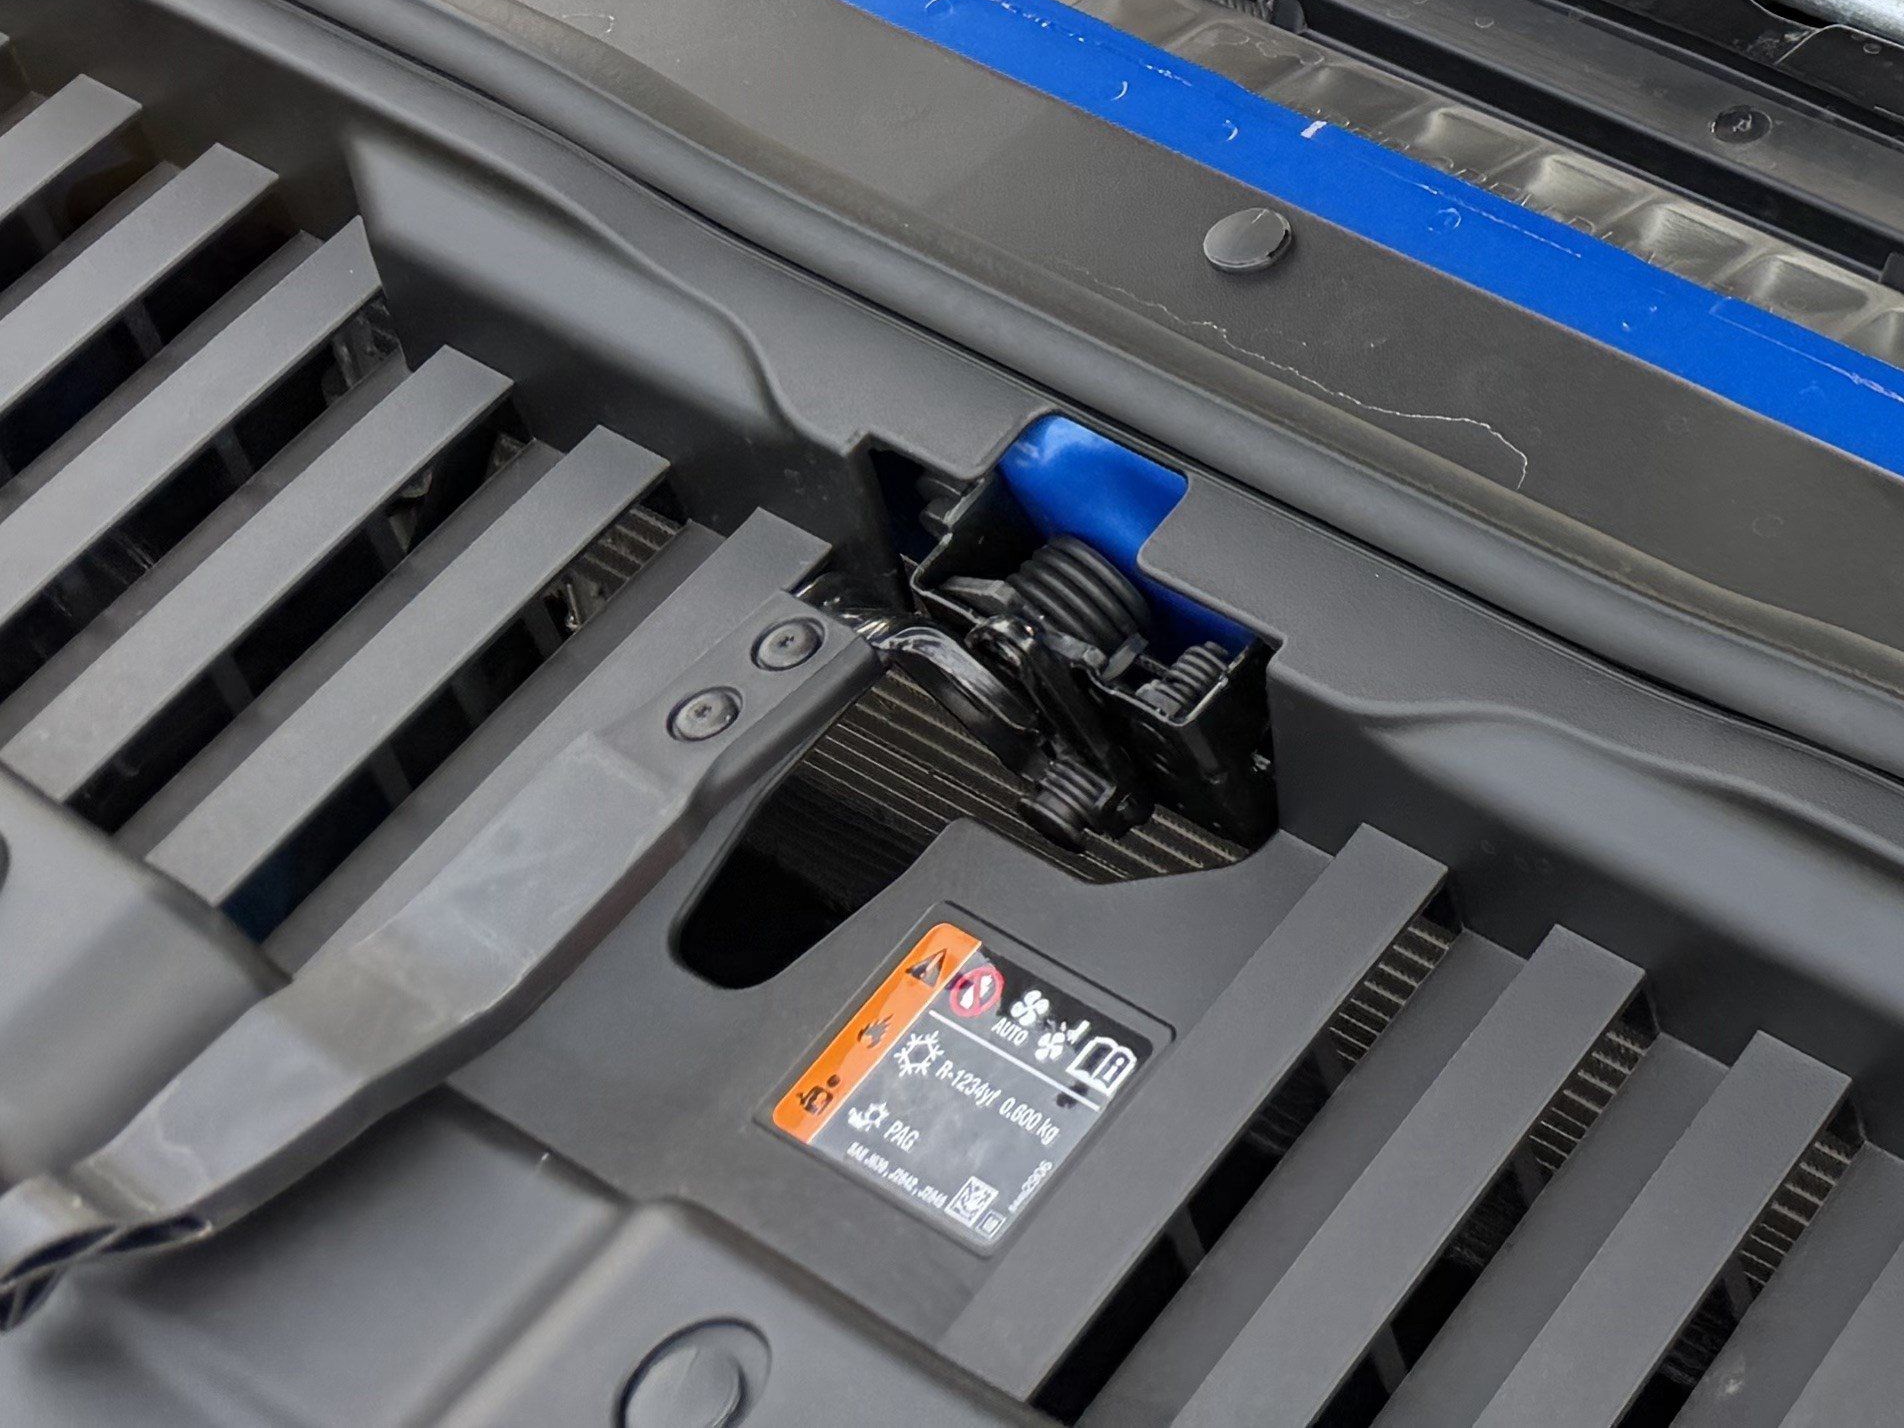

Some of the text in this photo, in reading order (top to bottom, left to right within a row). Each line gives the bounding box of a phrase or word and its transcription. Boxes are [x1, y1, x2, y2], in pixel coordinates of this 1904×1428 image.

[991, 1017, 1029, 1046] AUTO
[936, 1060, 1060, 1146] R-1234yf 0.600 kg
[883, 1121, 920, 1153] PAG
